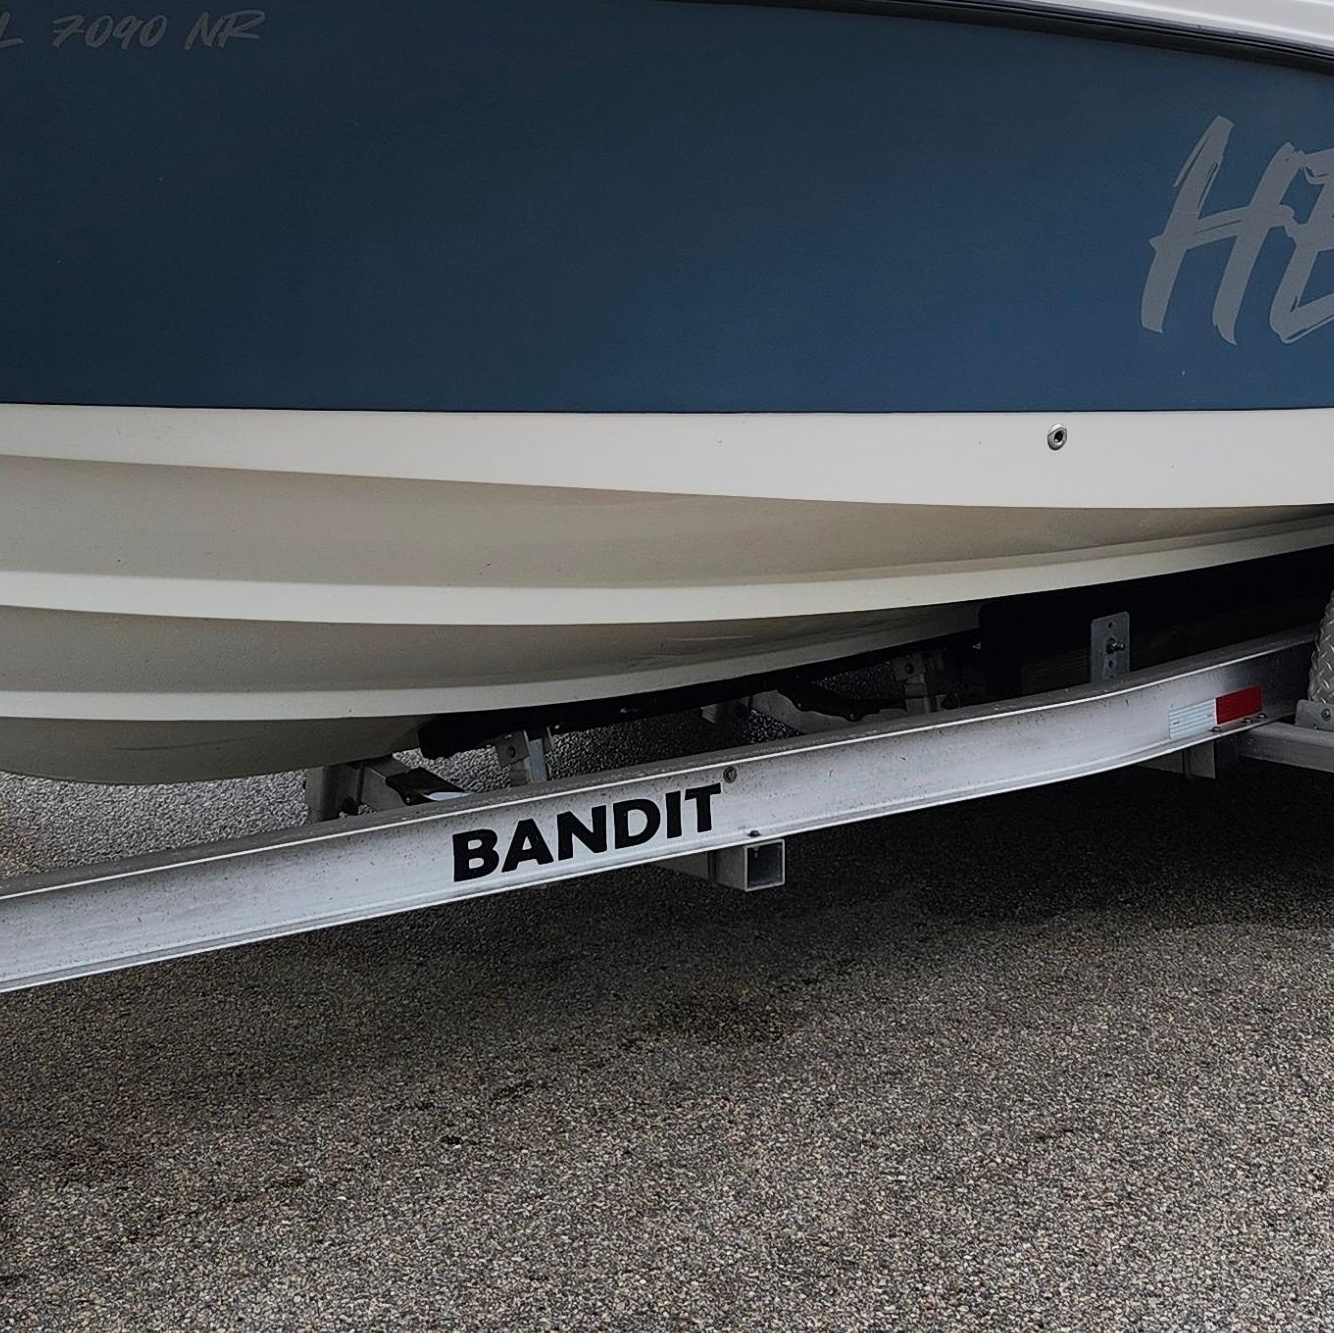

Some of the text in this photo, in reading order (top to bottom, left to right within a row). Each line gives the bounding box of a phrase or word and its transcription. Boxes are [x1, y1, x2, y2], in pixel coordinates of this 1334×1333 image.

[53, 14, 168, 50] 7090
[183, 9, 266, 51] NR
[452, 782, 722, 883] BANDIT
